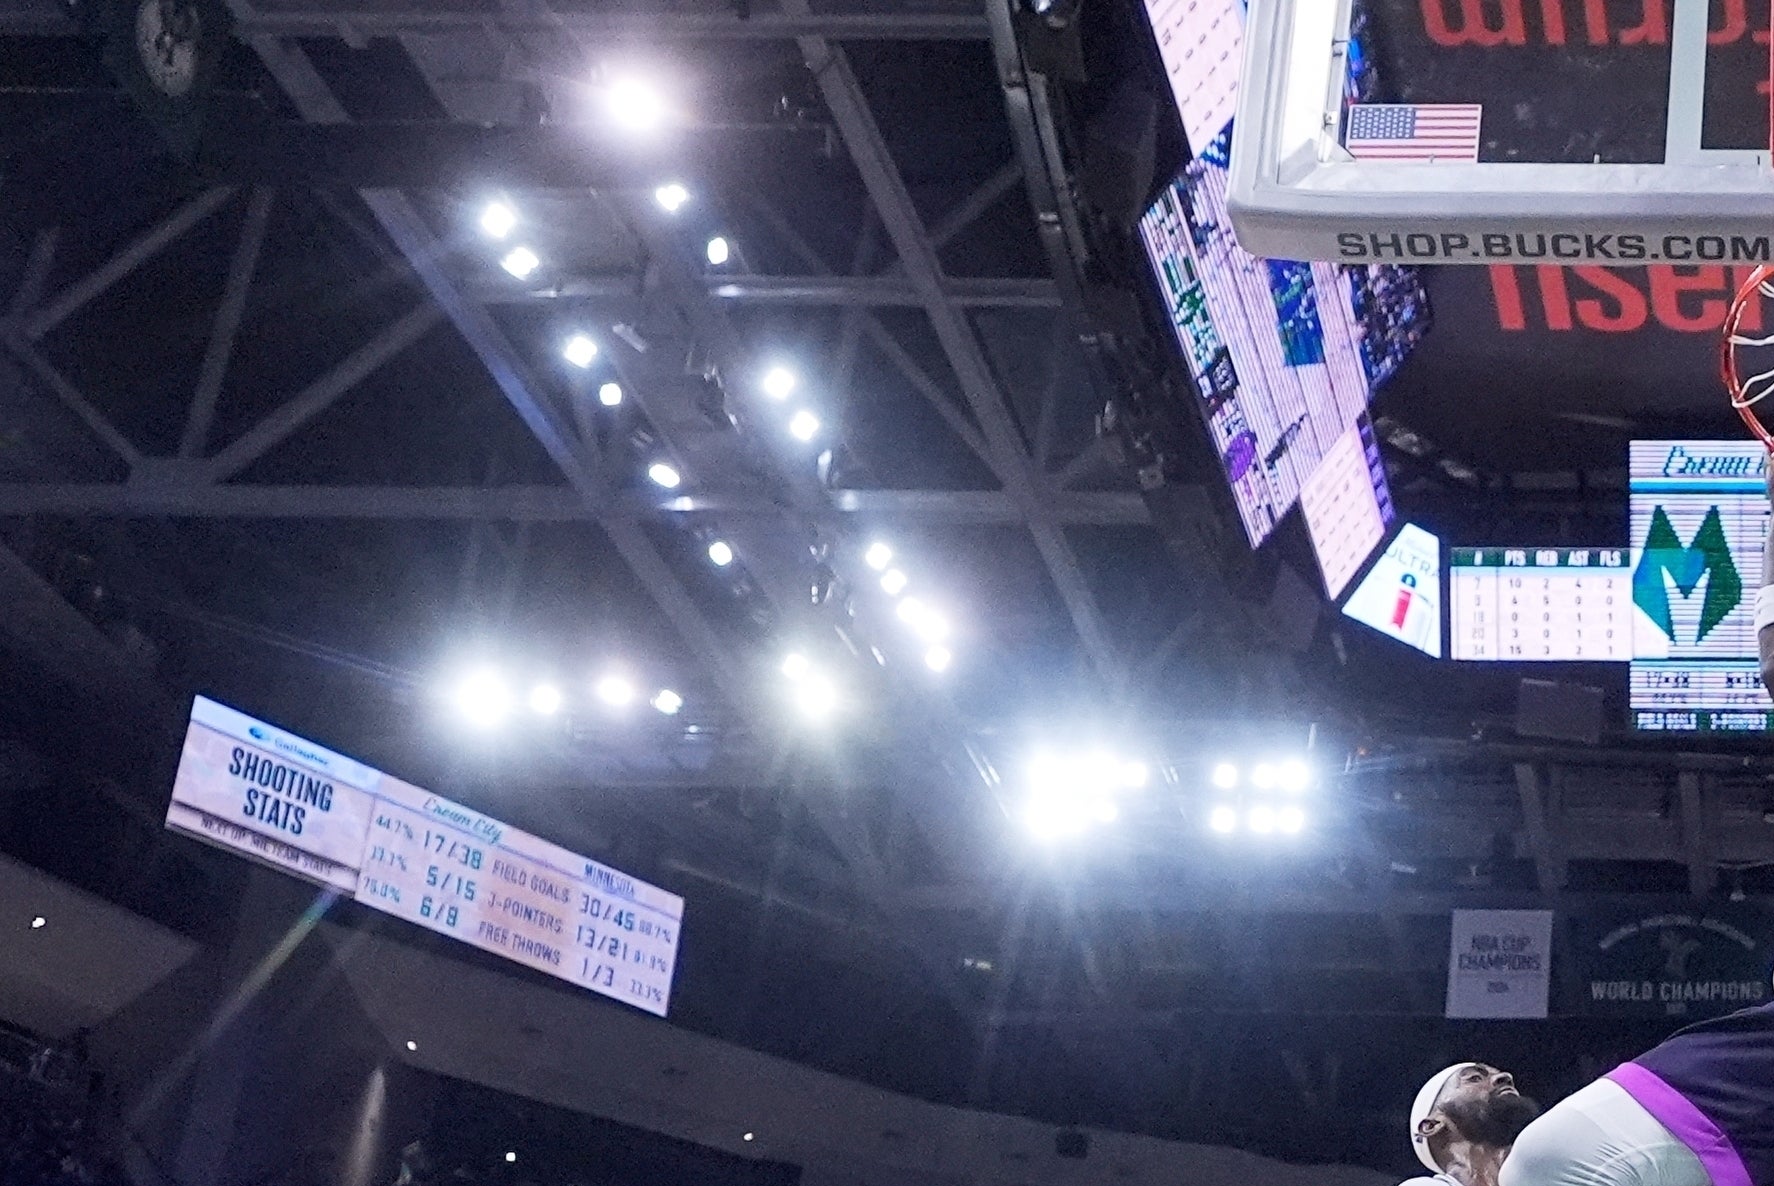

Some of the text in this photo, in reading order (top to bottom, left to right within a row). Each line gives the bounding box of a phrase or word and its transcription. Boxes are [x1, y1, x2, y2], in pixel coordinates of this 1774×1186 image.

[1337, 233, 1770, 261] SHOP.BUCKS.COM
[229, 746, 334, 812] SHOOTING
[243, 788, 306, 835] STATS
[424, 830, 483, 871] 17/38
[492, 859, 528, 889] FIELD
[530, 870, 571, 905] GOALS
[578, 893, 636, 932] 30/45
[583, 862, 636, 897] MINNESOTA
[426, 864, 477, 902] 5/15
[488, 893, 565, 935] 3-POINTERS
[576, 924, 629, 960] 13/21
[420, 896, 459, 928] 6/8
[479, 920, 509, 947] FREE
[511, 932, 562, 967] THROWS
[582, 958, 614, 988] 1/3
[1591, 980, 1765, 1001] WORLD CHAMPIONS
